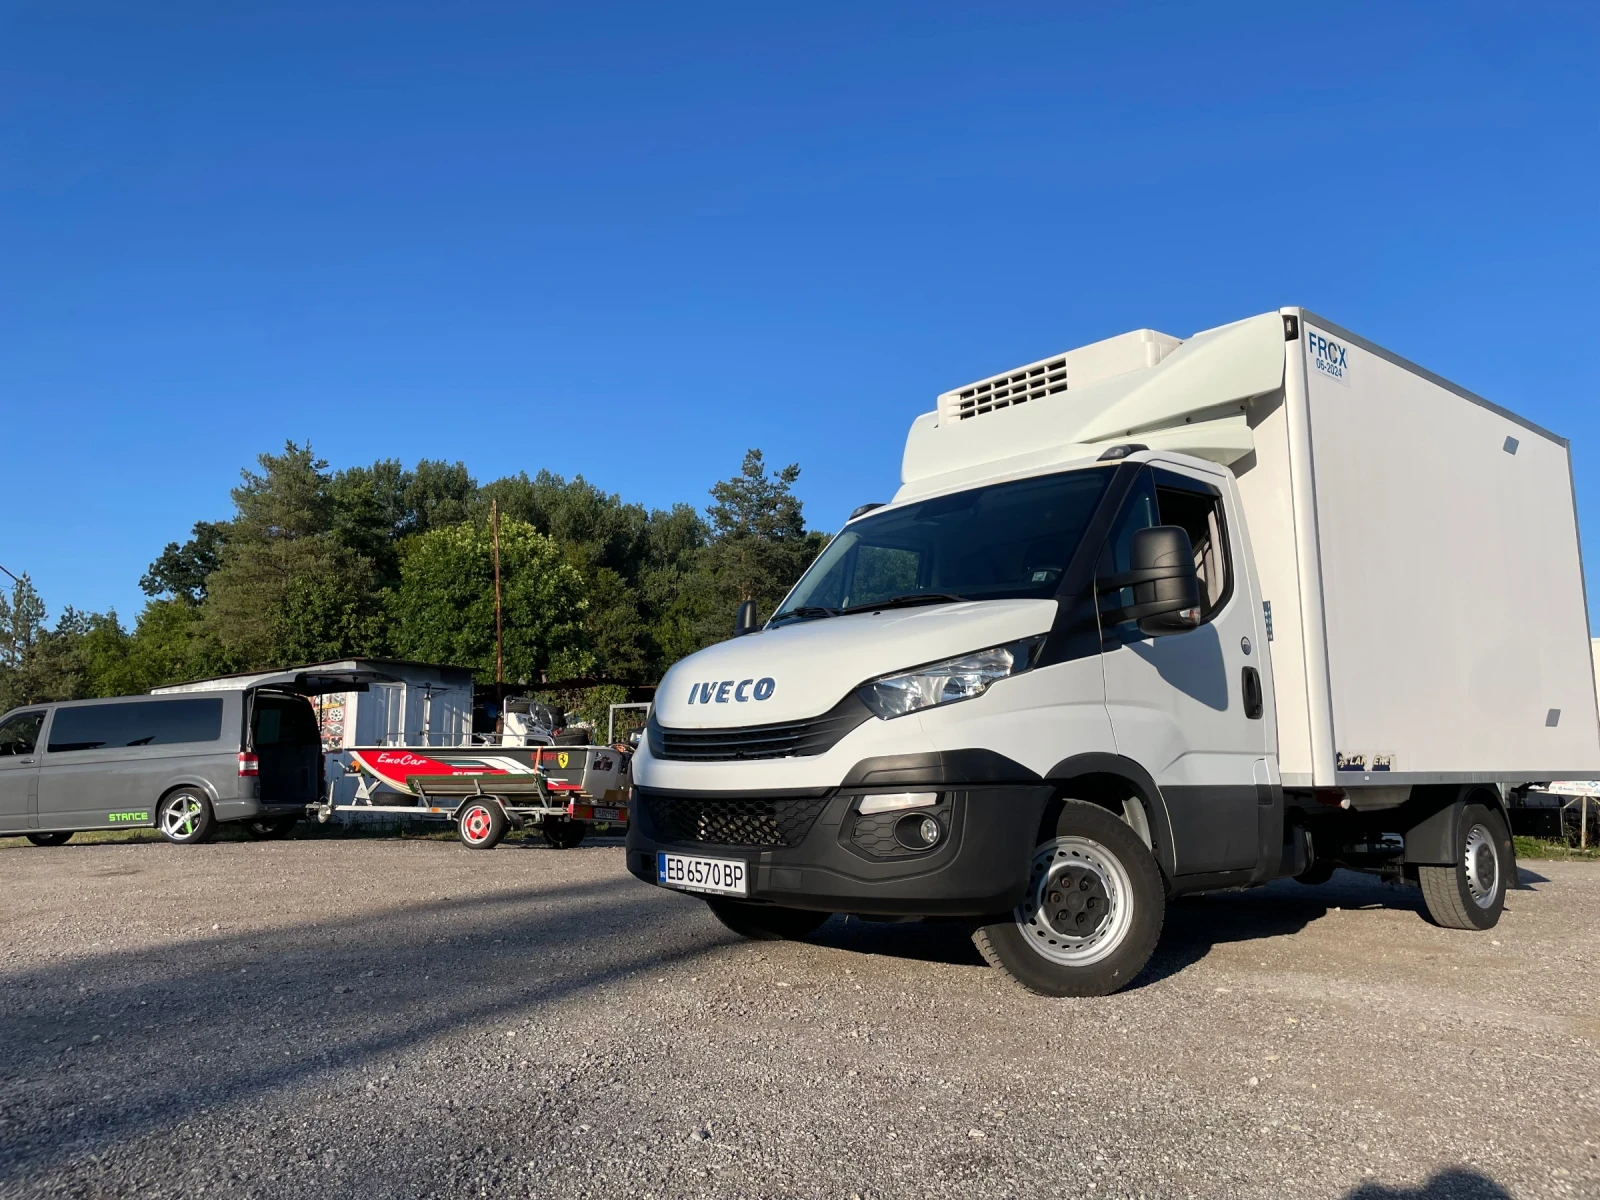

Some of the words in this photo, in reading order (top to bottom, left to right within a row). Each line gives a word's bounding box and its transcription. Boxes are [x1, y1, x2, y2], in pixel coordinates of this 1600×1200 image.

[1308, 331, 1347, 369] FRCX
[1315, 357, 1342, 378] 06-2024
[687, 677, 776, 705] IVECO
[377, 752, 427, 766] EmoCar
[108, 811, 149, 822] STANCE
[667, 857, 684, 881] EB
[687, 860, 721, 886] 6570
[723, 863, 743, 888] BP
